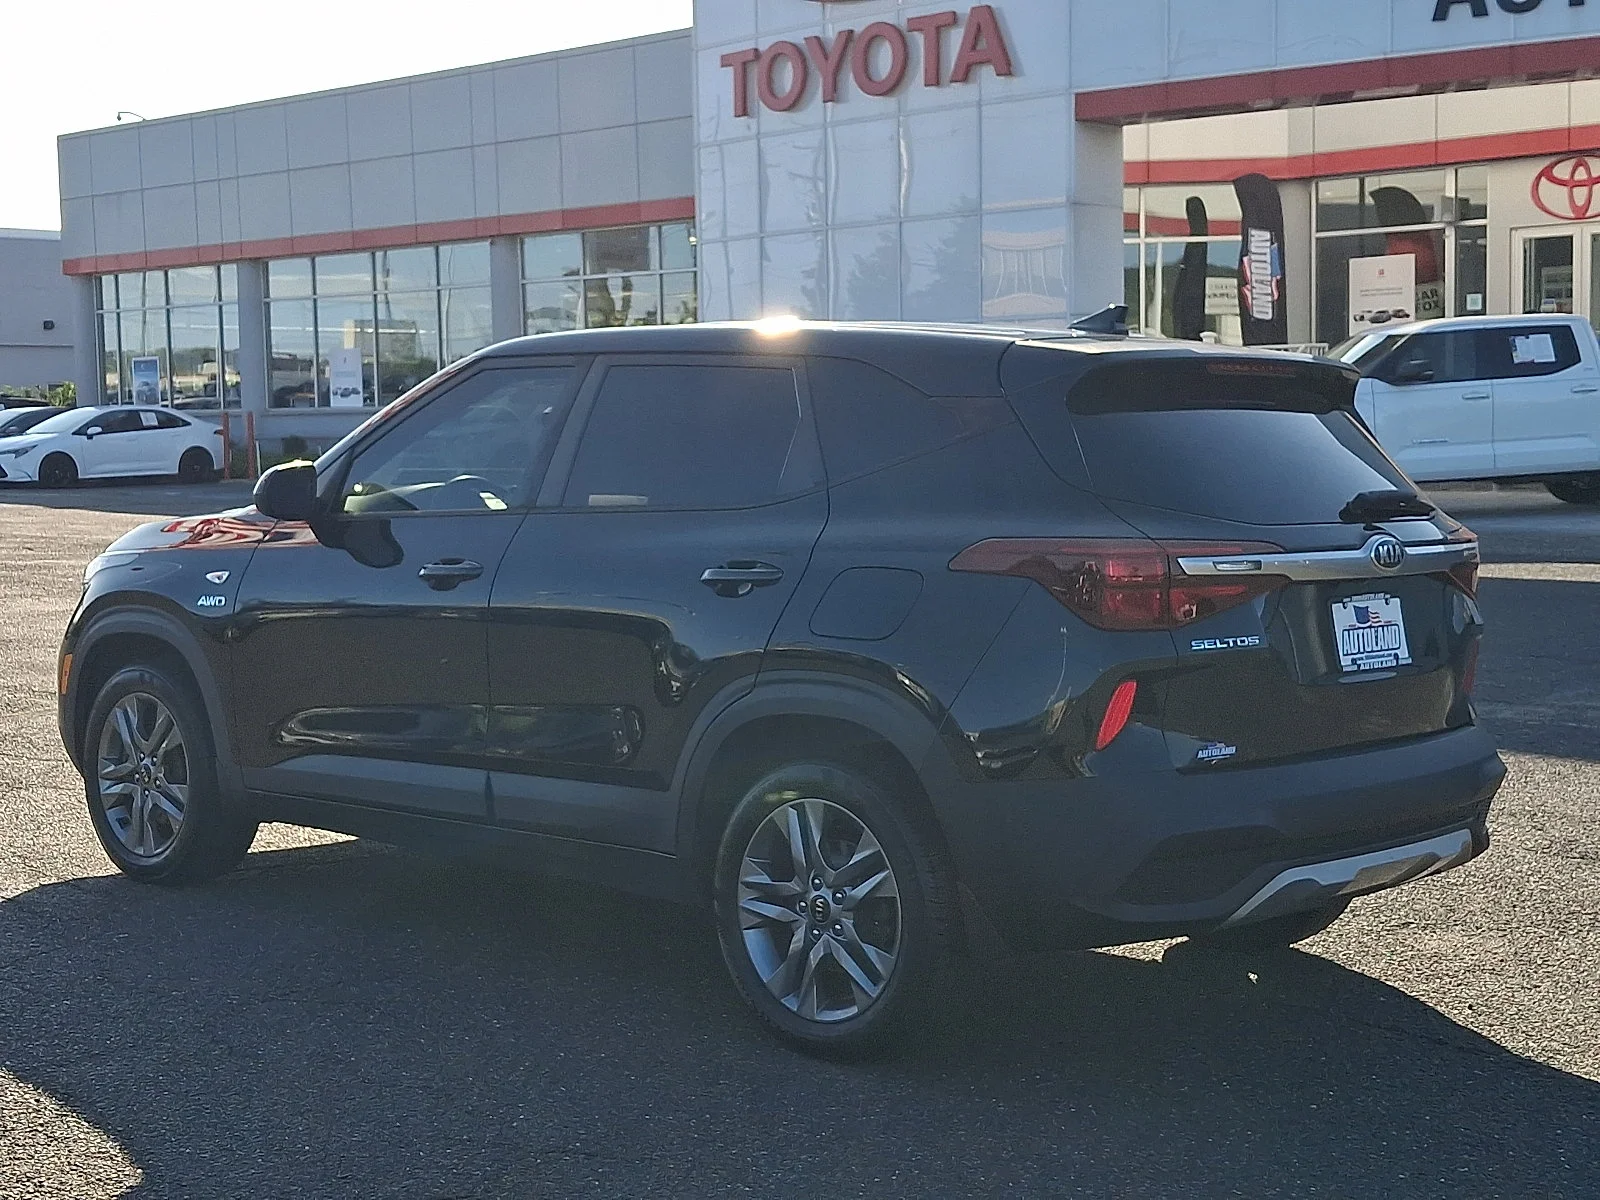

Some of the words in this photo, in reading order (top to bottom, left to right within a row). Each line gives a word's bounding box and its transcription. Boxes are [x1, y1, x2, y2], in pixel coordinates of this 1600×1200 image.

[720, 4, 1014, 118] TOYOTA
[1249, 229, 1272, 320] AUTOLAND
[1377, 544, 1402, 564] KIA
[197, 595, 226, 606] AWD
[1191, 636, 1260, 650] SELTOS
[1343, 625, 1400, 655] AUTOLAND
[1359, 660, 1397, 670] AUTOLAND
[1197, 746, 1237, 759] AUTOLAND
